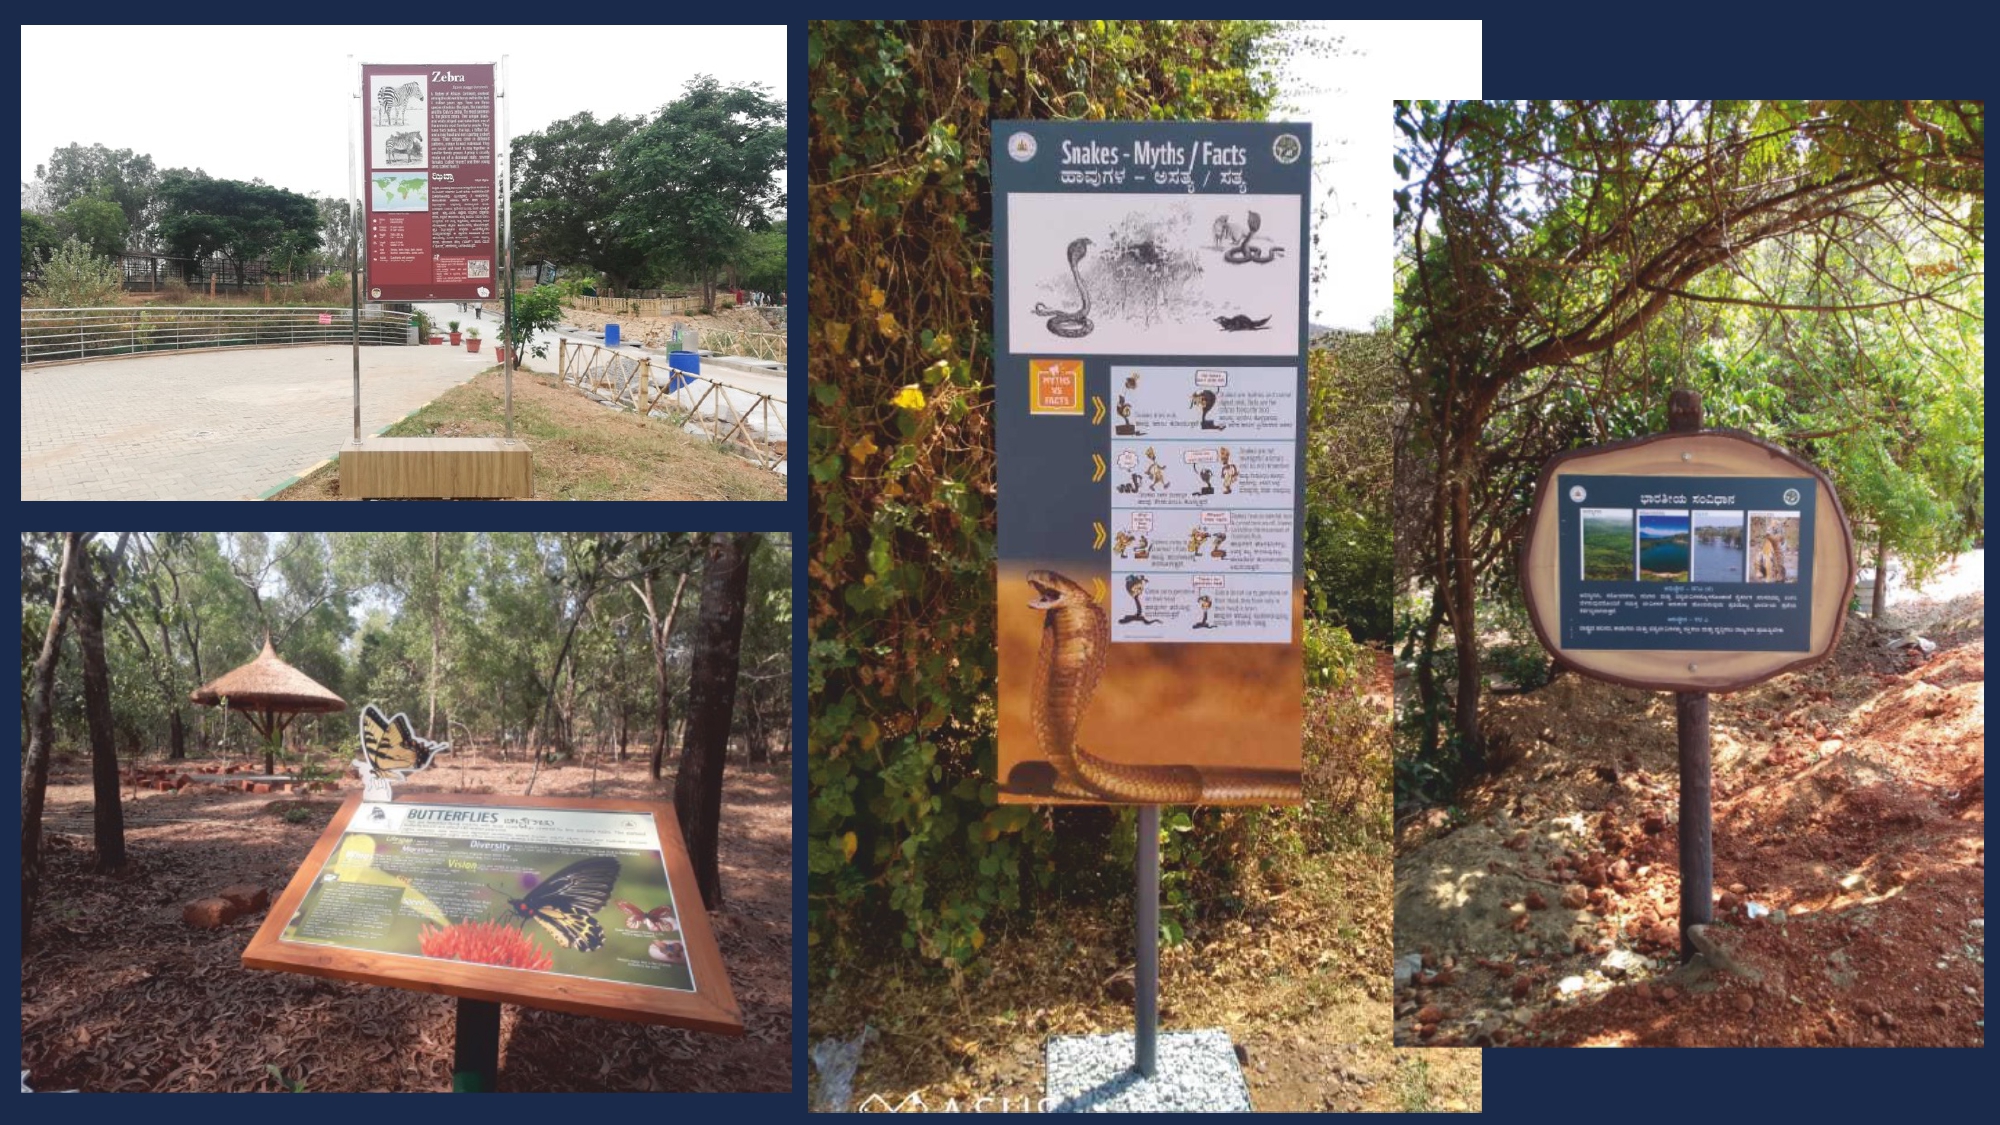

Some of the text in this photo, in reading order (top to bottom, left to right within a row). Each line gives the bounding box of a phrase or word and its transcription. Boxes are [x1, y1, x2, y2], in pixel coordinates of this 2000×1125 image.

[431, 70, 465, 82] Zebra
[1062, 140, 1118, 165] Snakes
[1134, 140, 1185, 169] Myths
[1203, 141, 1247, 165] Facts
[1042, 376, 1070, 385] MYTHS
[1044, 396, 1070, 405] FACTS
[407, 808, 500, 823] BUTTERFLIES
[470, 840, 511, 852] Diversity
[448, 859, 478, 870] Vision
